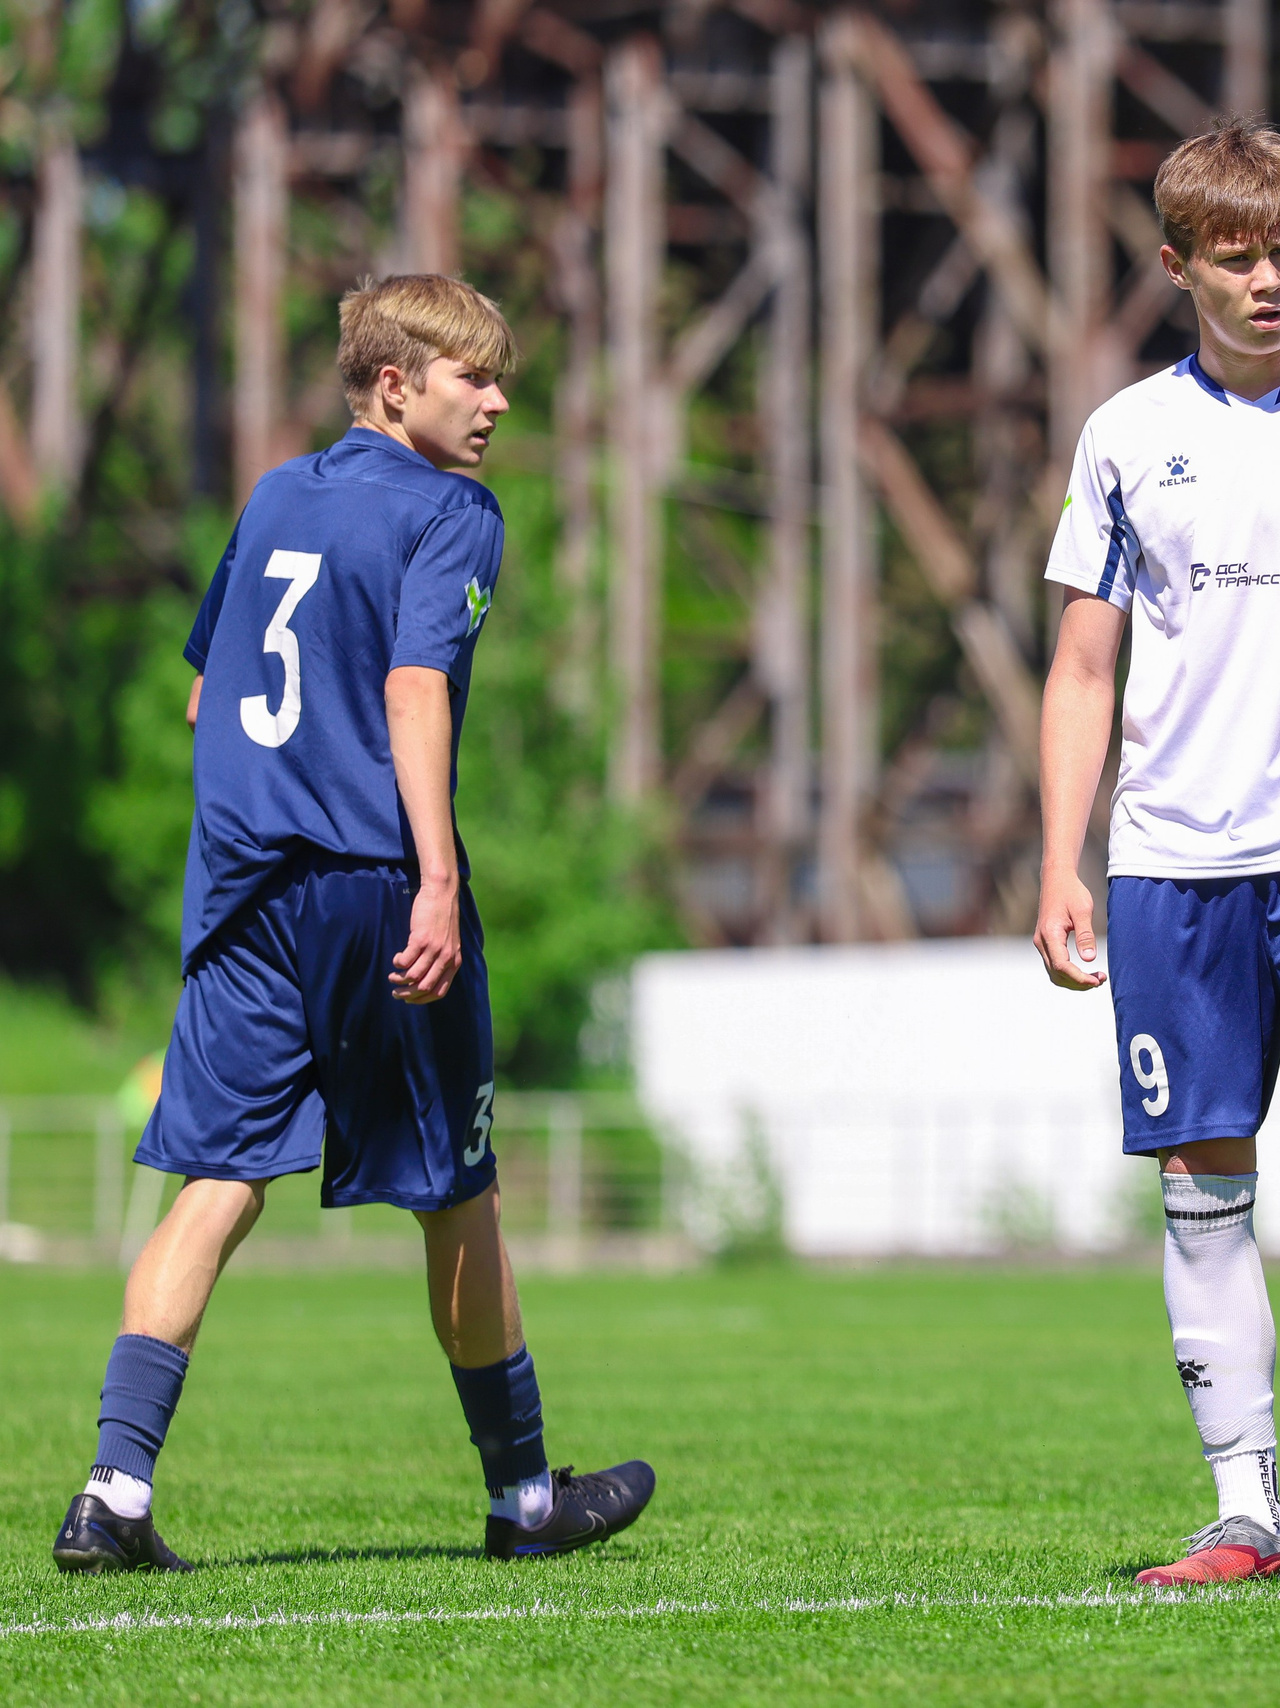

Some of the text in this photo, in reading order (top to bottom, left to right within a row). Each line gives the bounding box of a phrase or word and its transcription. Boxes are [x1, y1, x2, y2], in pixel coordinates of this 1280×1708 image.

[1159, 475, 1197, 488] KELME
[1215, 562, 1249, 576] ДСК
[240, 549, 322, 748] 3
[1129, 1033, 1170, 1117] 9
[463, 1081, 494, 1168] 3
